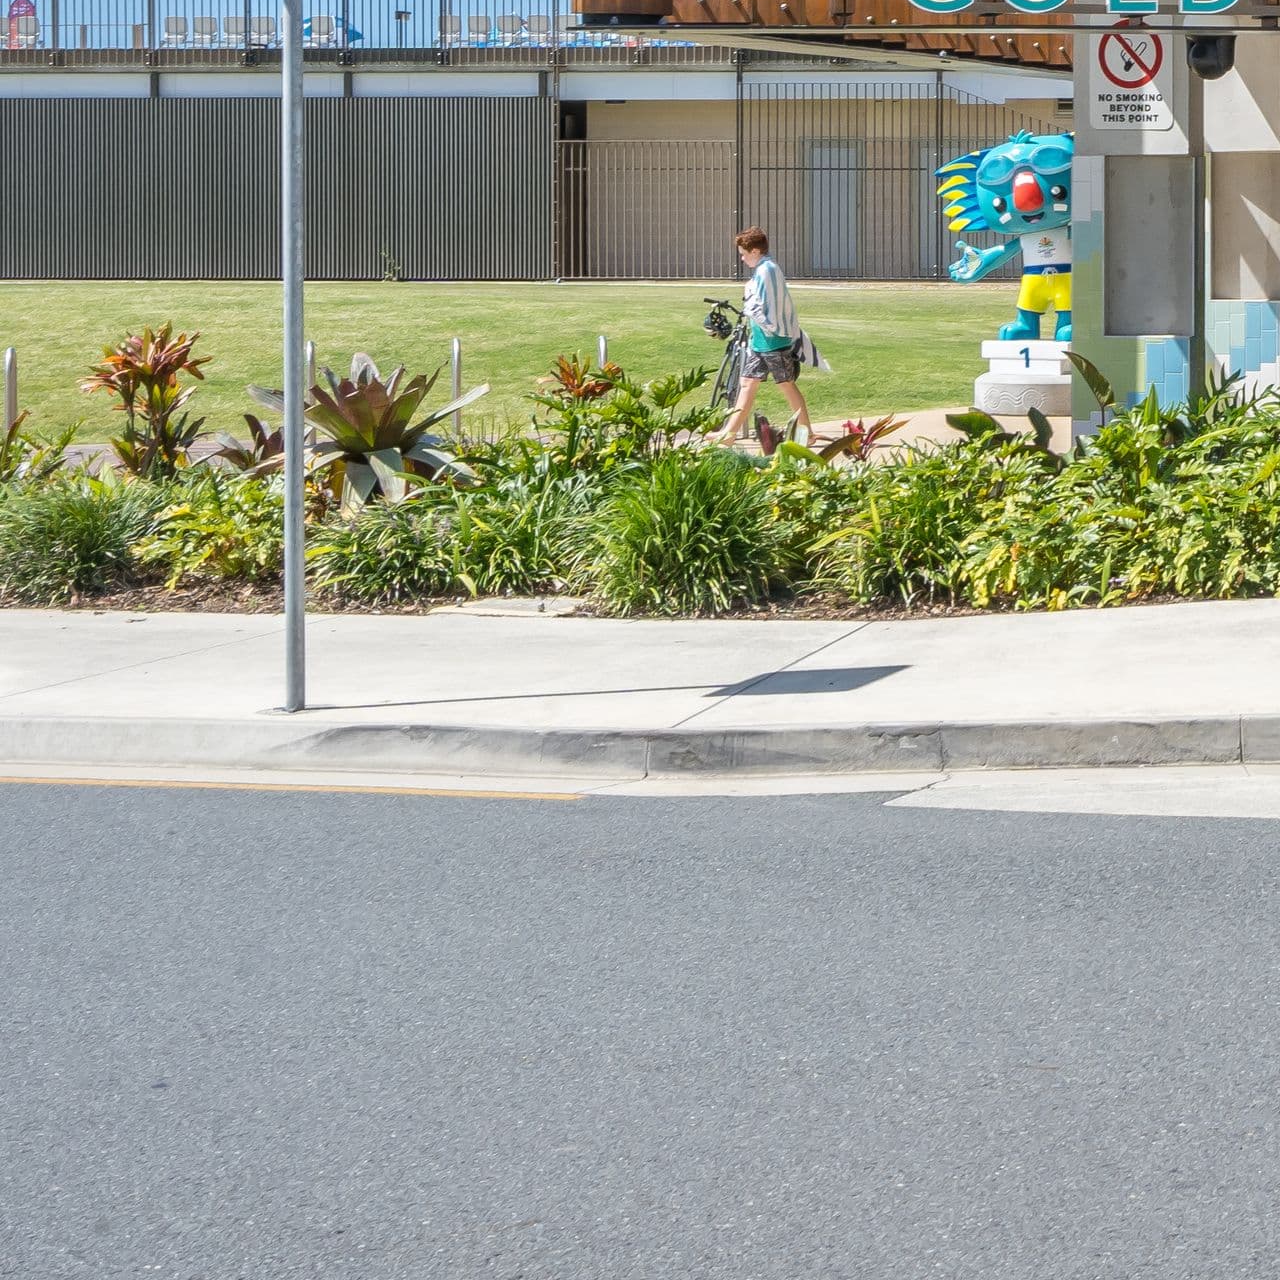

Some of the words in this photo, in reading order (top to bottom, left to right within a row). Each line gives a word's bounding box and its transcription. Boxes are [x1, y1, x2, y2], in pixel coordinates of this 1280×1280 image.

[1098, 93, 1113, 102] NO
[1115, 93, 1163, 102] SMOKING
[1109, 104, 1152, 112] BEYOND
[1102, 114, 1126, 122] THIS
[1128, 114, 1159, 123] POINT
[1019, 347, 1030, 369] 1
